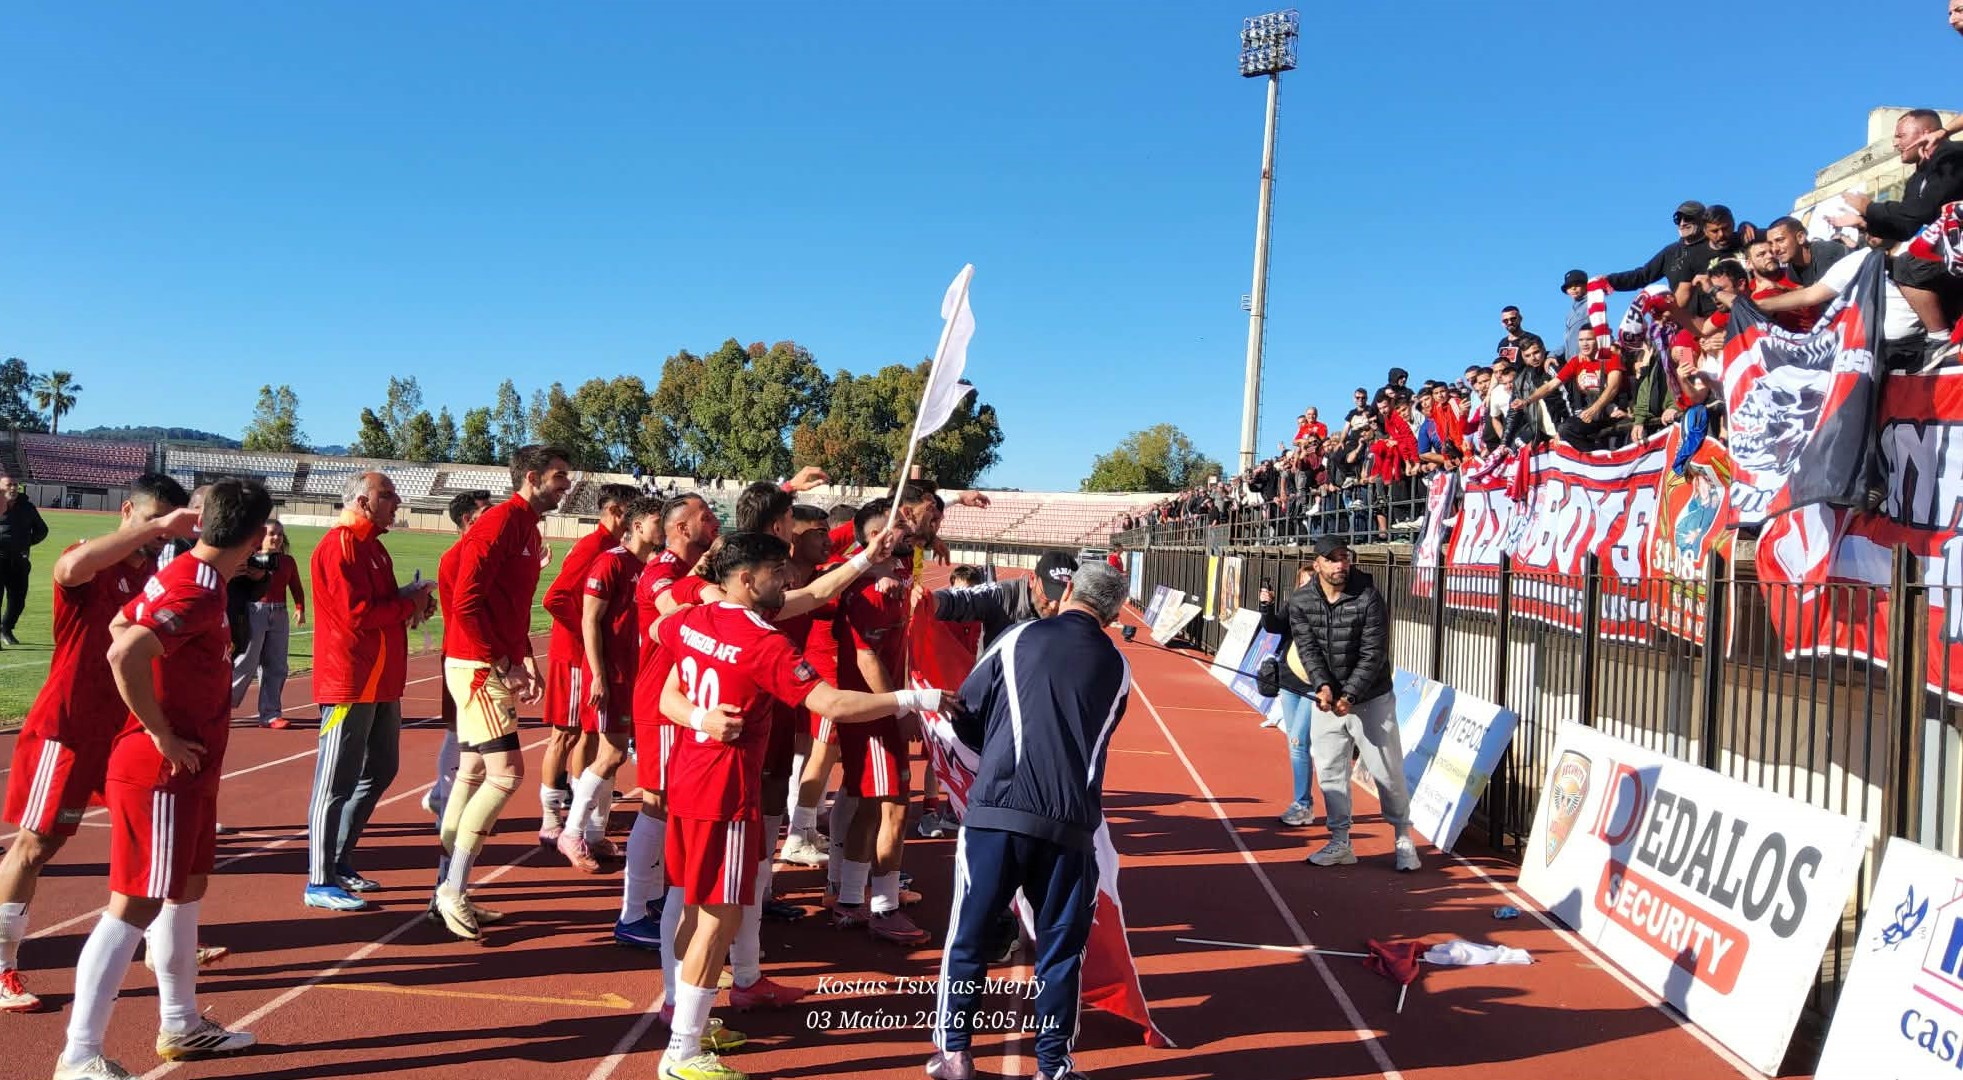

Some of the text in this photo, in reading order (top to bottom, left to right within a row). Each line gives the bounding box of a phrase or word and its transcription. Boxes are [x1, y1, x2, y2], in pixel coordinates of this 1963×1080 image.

[1526, 479, 1655, 586] BOYS
[713, 642, 743, 664] AFC
[1588, 757, 1823, 940] DEDALOS
[1604, 872, 1737, 976] SECURITY
